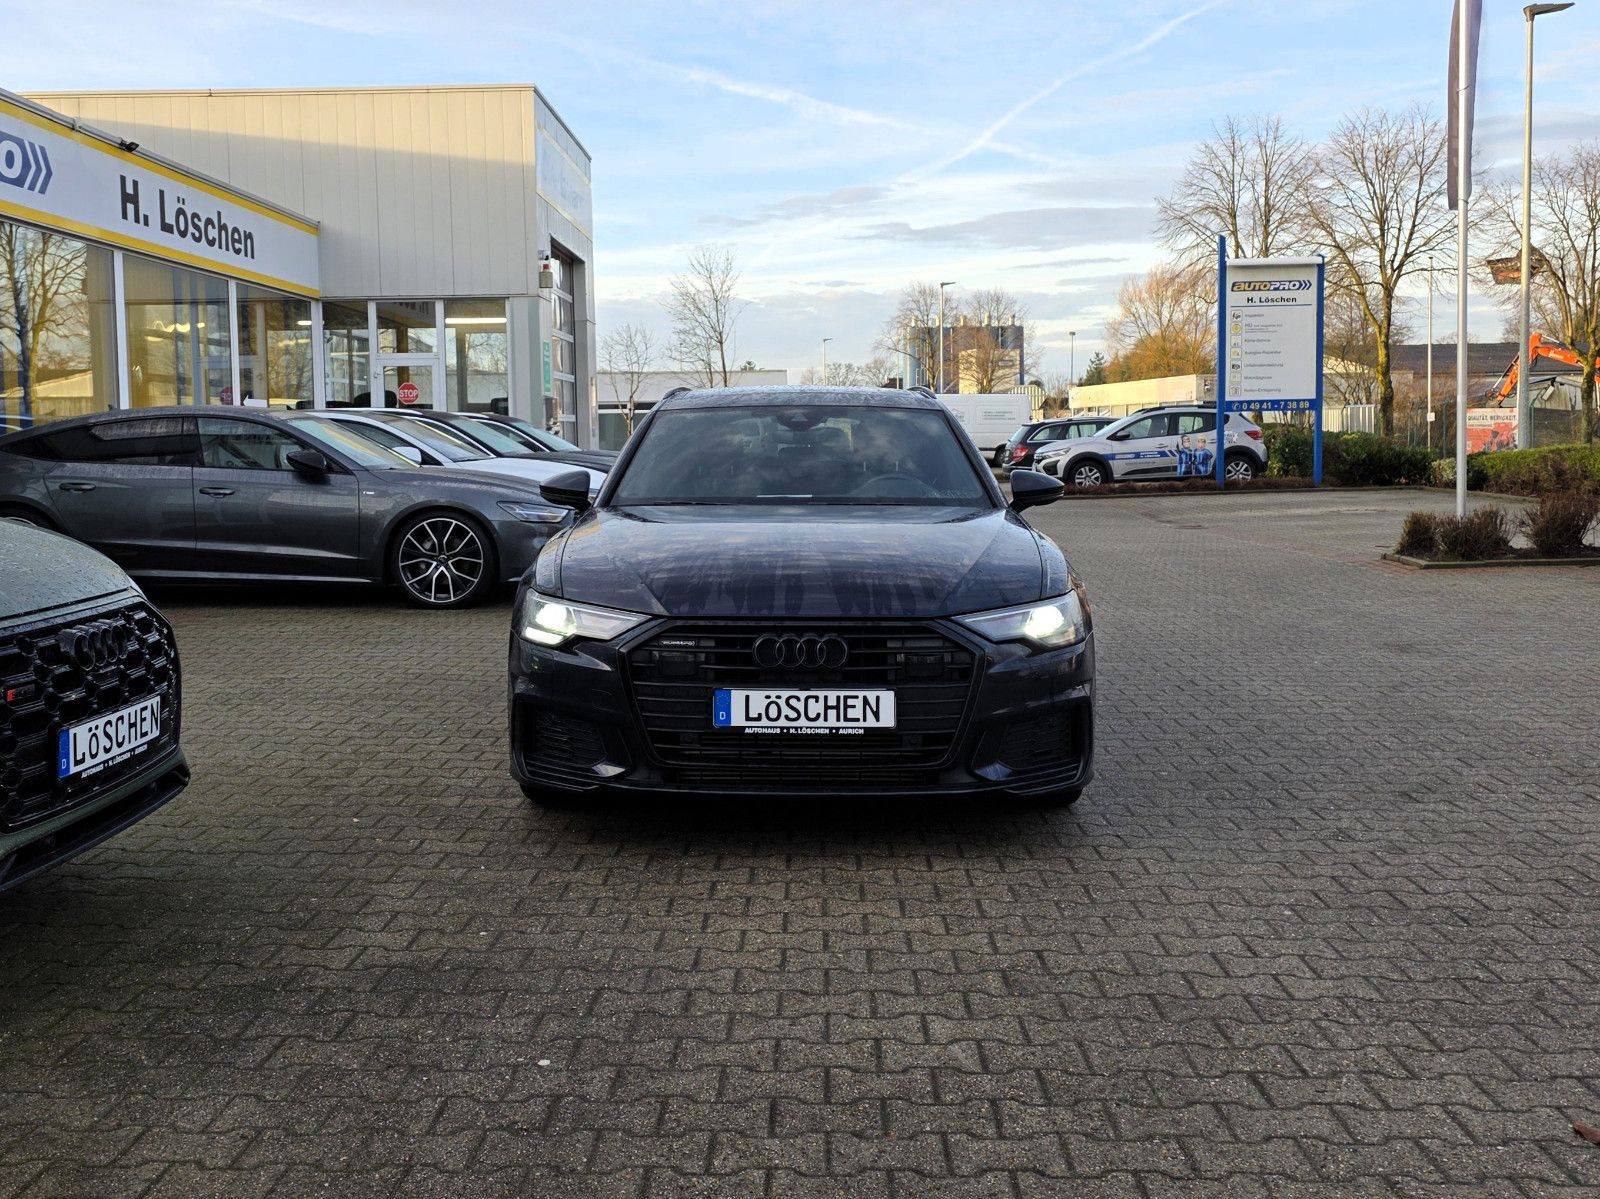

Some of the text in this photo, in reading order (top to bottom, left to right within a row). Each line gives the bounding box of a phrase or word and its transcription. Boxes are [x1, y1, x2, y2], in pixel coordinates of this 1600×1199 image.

[119, 174, 256, 260] H. Löschen
[1246, 296, 1297, 304] H. Löschen
[399, 389, 418, 397] STOP
[1242, 402, 1248, 410] 0
[1249, 402, 1260, 410] 49
[1261, 402, 1272, 410] 41
[1280, 401, 1285, 409] 7
[1286, 401, 1297, 409] 38
[719, 711, 726, 720] D
[61, 758, 67, 770] D
